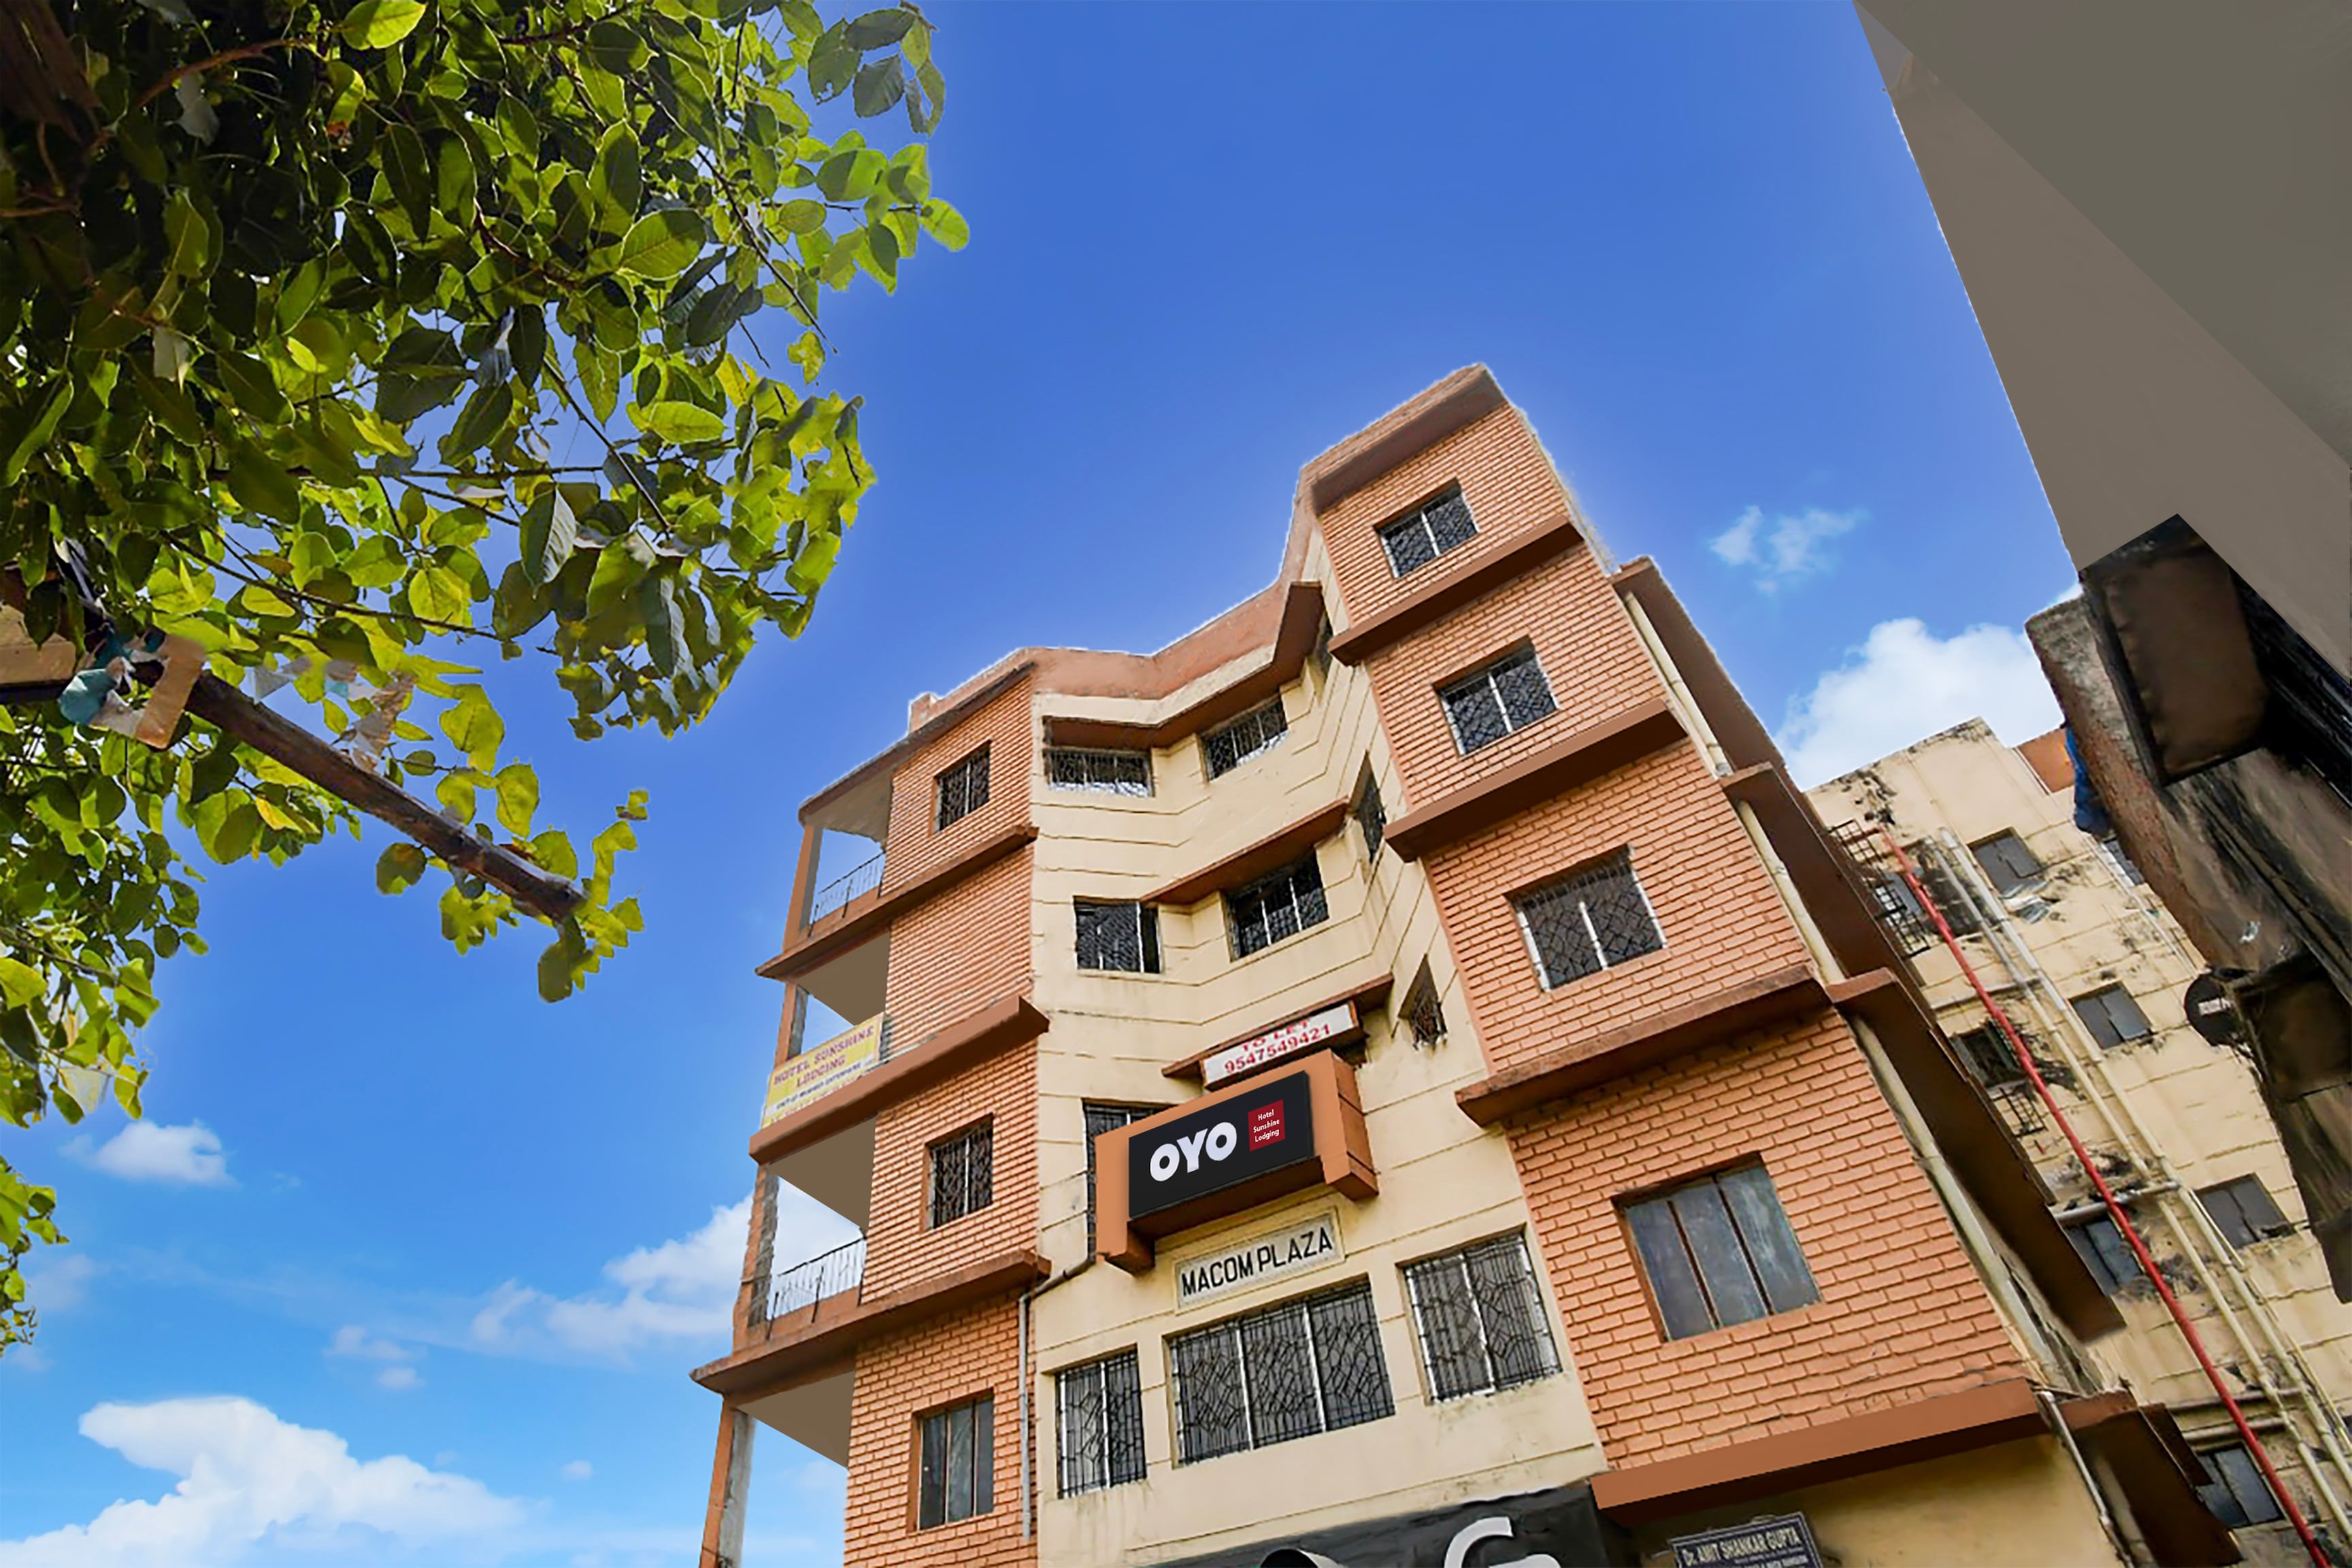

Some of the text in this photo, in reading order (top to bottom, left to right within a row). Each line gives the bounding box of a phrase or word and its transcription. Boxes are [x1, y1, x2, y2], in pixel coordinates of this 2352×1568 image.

[774, 1060, 810, 1086] HOTEL
[814, 1026, 875, 1065] SUNSHINE
[1224, 1023, 1331, 1073] 9547549421
[796, 1055, 846, 1088] LODGING
[1253, 1118, 1280, 1133] Sunshine
[1257, 1109, 1274, 1122] Hotel
[1149, 1122, 1238, 1182] OYO
[1255, 1129, 1280, 1143] Lodging
[1181, 1227, 1333, 1297] MACOM PLAZA
[1766, 1527, 1802, 1550] GUPTA
